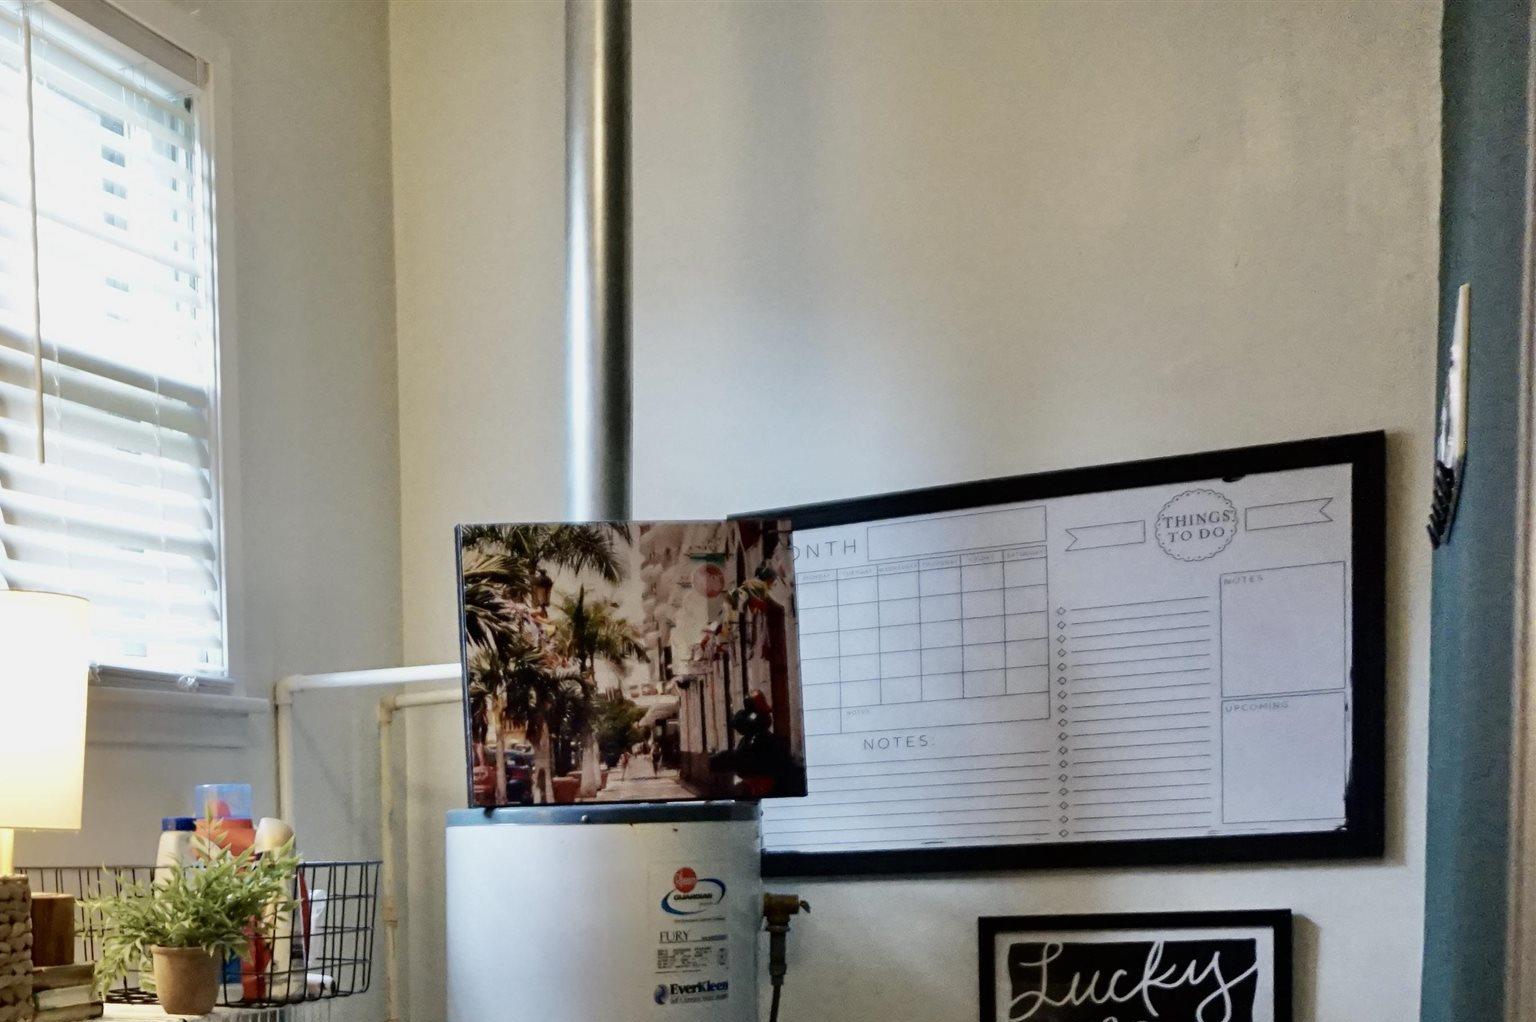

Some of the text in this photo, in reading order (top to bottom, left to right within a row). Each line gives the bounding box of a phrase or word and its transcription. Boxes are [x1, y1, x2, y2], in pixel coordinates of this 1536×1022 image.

[1163, 509, 1231, 529] THINGS
[1168, 527, 1225, 543] TO DO
[864, 733, 936, 750] NOTES:
[659, 929, 689, 943] FURY
[669, 980, 729, 995] EverKleen
